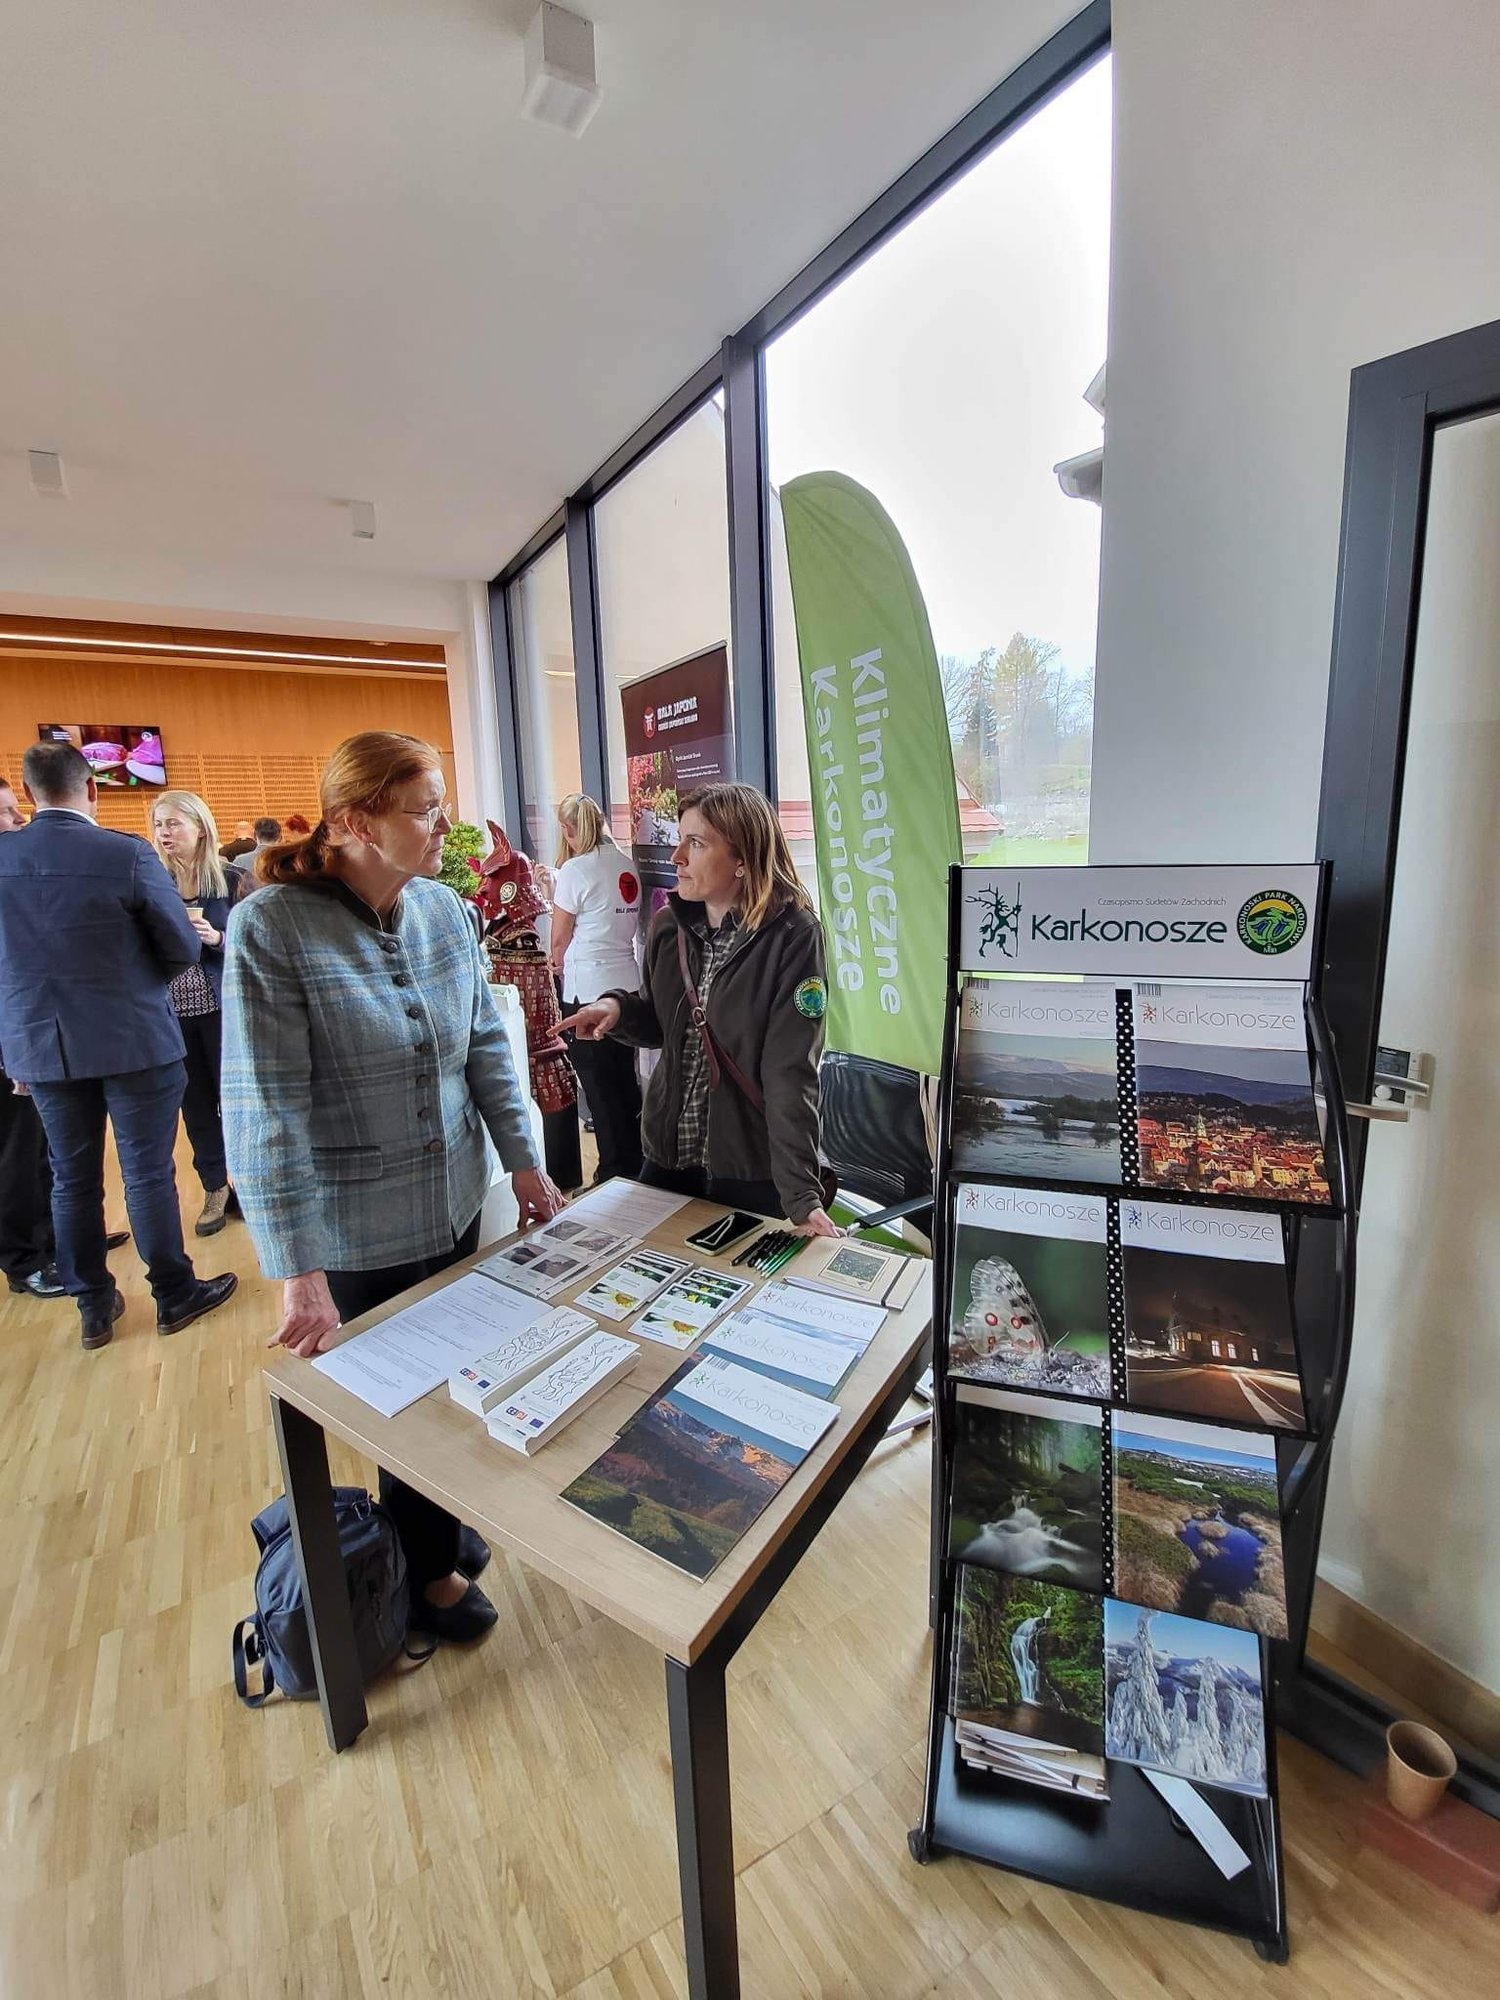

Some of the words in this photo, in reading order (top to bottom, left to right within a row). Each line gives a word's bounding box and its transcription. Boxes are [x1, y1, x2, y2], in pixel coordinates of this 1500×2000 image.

[811, 664, 864, 992] Karkonosze
[850, 647, 901, 1016] Klimatyczne
[1031, 908, 1228, 943] Karkonosze
[1239, 895, 1263, 945] KARKONOSKI
[1264, 892, 1287, 900] PARK
[1287, 897, 1305, 946] NARODOWY
[987, 1000, 1109, 1023] Karkonosze
[1162, 1004, 1296, 1030] Karkonosze
[983, 1191, 1100, 1222] Karkonosze
[1147, 1210, 1275, 1242] Karkonosze
[776, 1295, 875, 1329] Karkonosze
[734, 1332, 839, 1373] Karkonosze
[708, 1379, 817, 1434] Karkonosze
